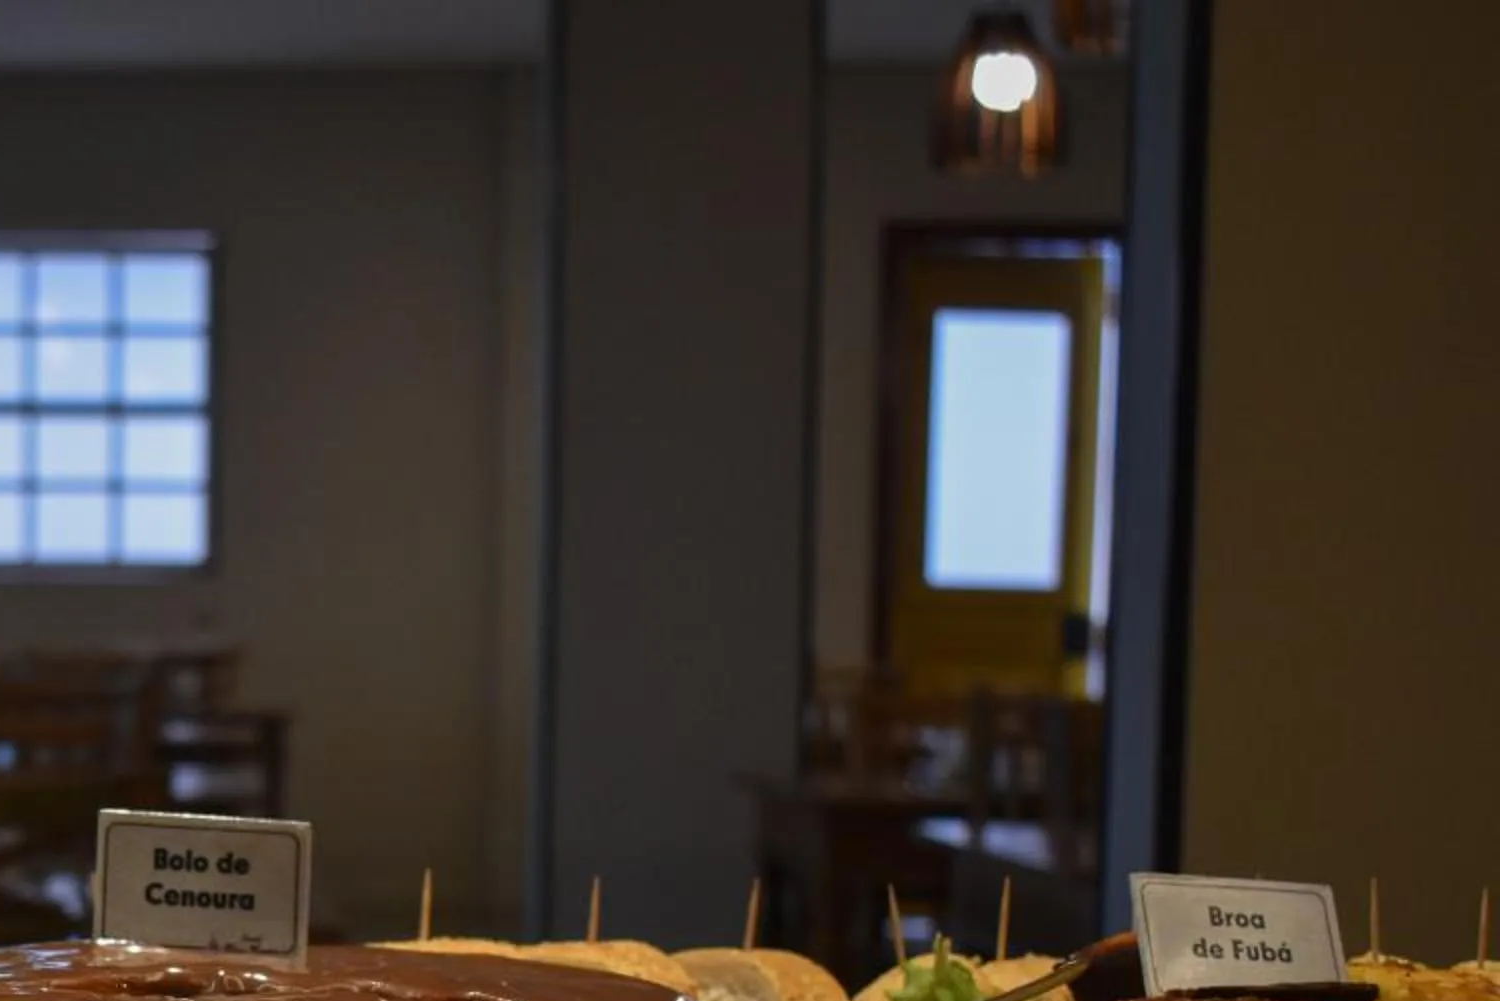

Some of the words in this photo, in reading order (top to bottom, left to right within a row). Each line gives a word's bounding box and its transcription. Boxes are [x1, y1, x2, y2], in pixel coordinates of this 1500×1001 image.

[153, 848, 209, 873] Bolo
[217, 852, 249, 875] de
[145, 882, 255, 911] Cenoura
[1208, 905, 1266, 930] Broa
[1192, 938, 1224, 959] de
[1231, 939, 1293, 963] Fubá
